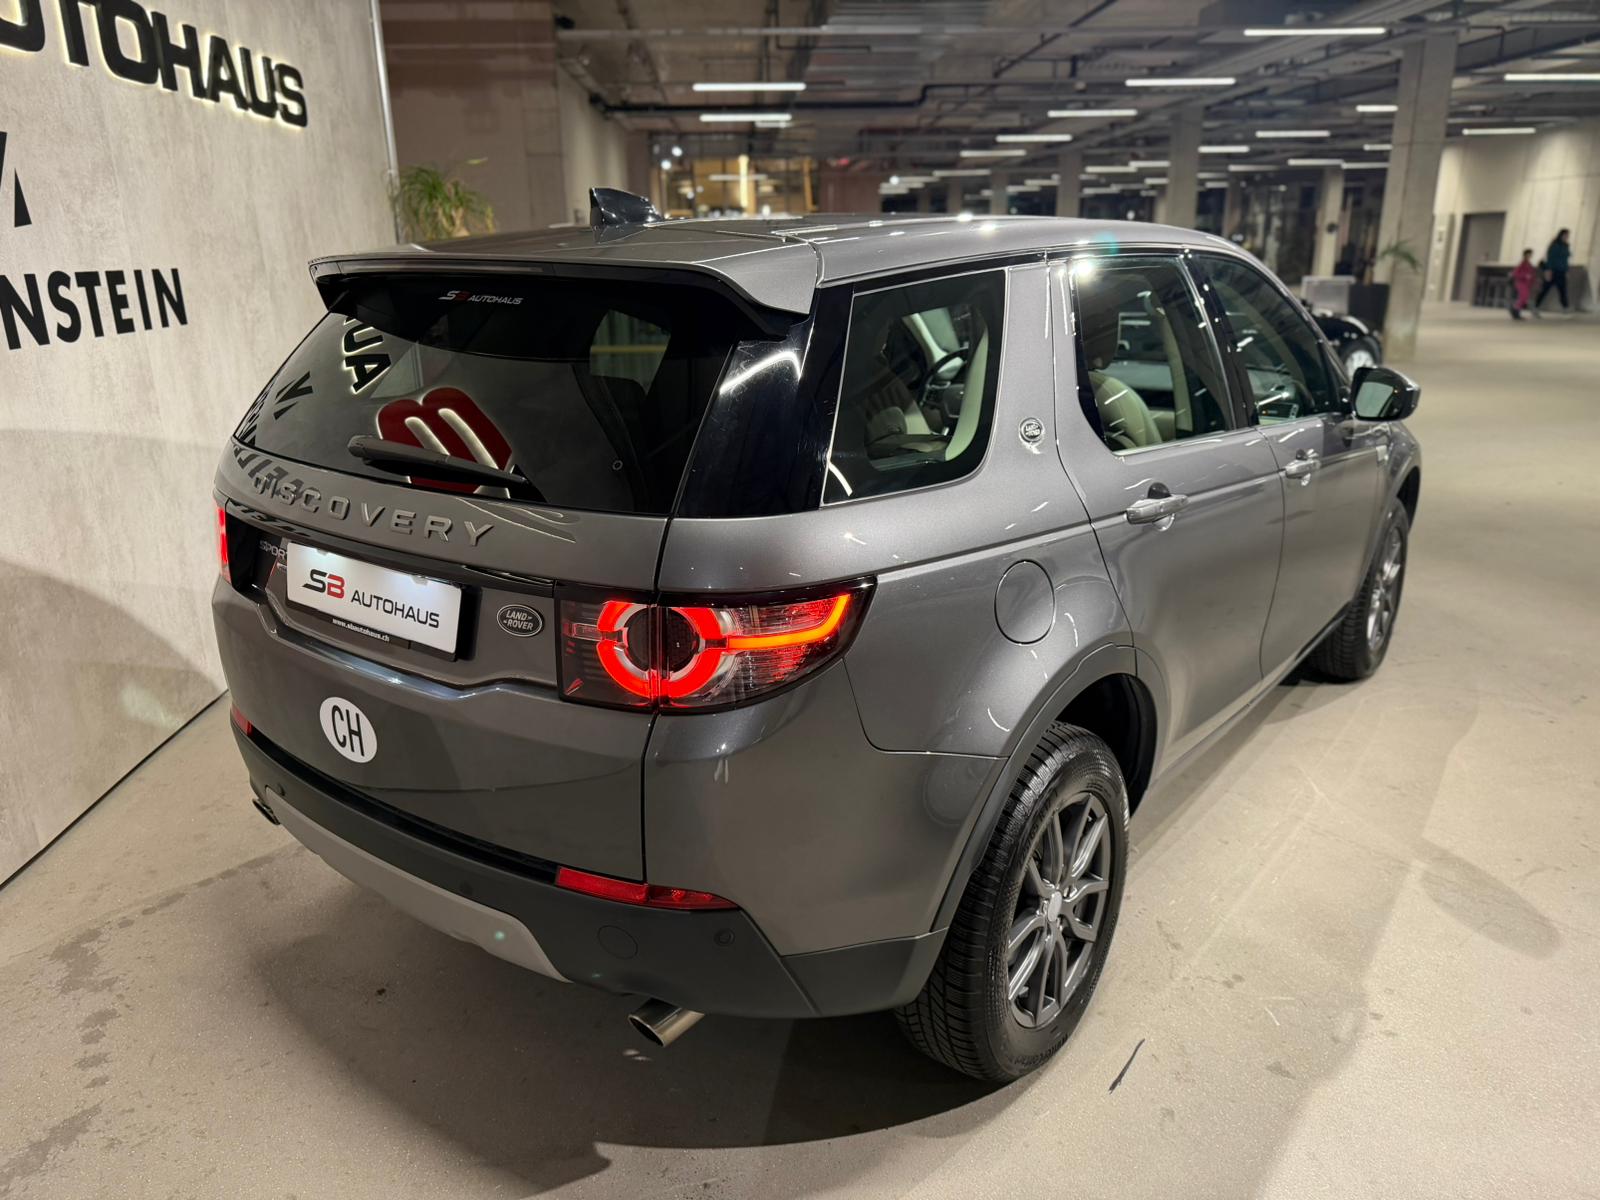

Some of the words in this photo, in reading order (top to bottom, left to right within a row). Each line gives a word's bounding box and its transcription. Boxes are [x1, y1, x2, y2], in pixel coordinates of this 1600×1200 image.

[467, 294, 524, 305] AUTOHAUS
[251, 474, 494, 547] DISCOVERY
[258, 539, 288, 560] SPOR
[302, 568, 346, 599] SB
[350, 589, 440, 629] AUTOHAUS
[331, 704, 365, 757] CH
